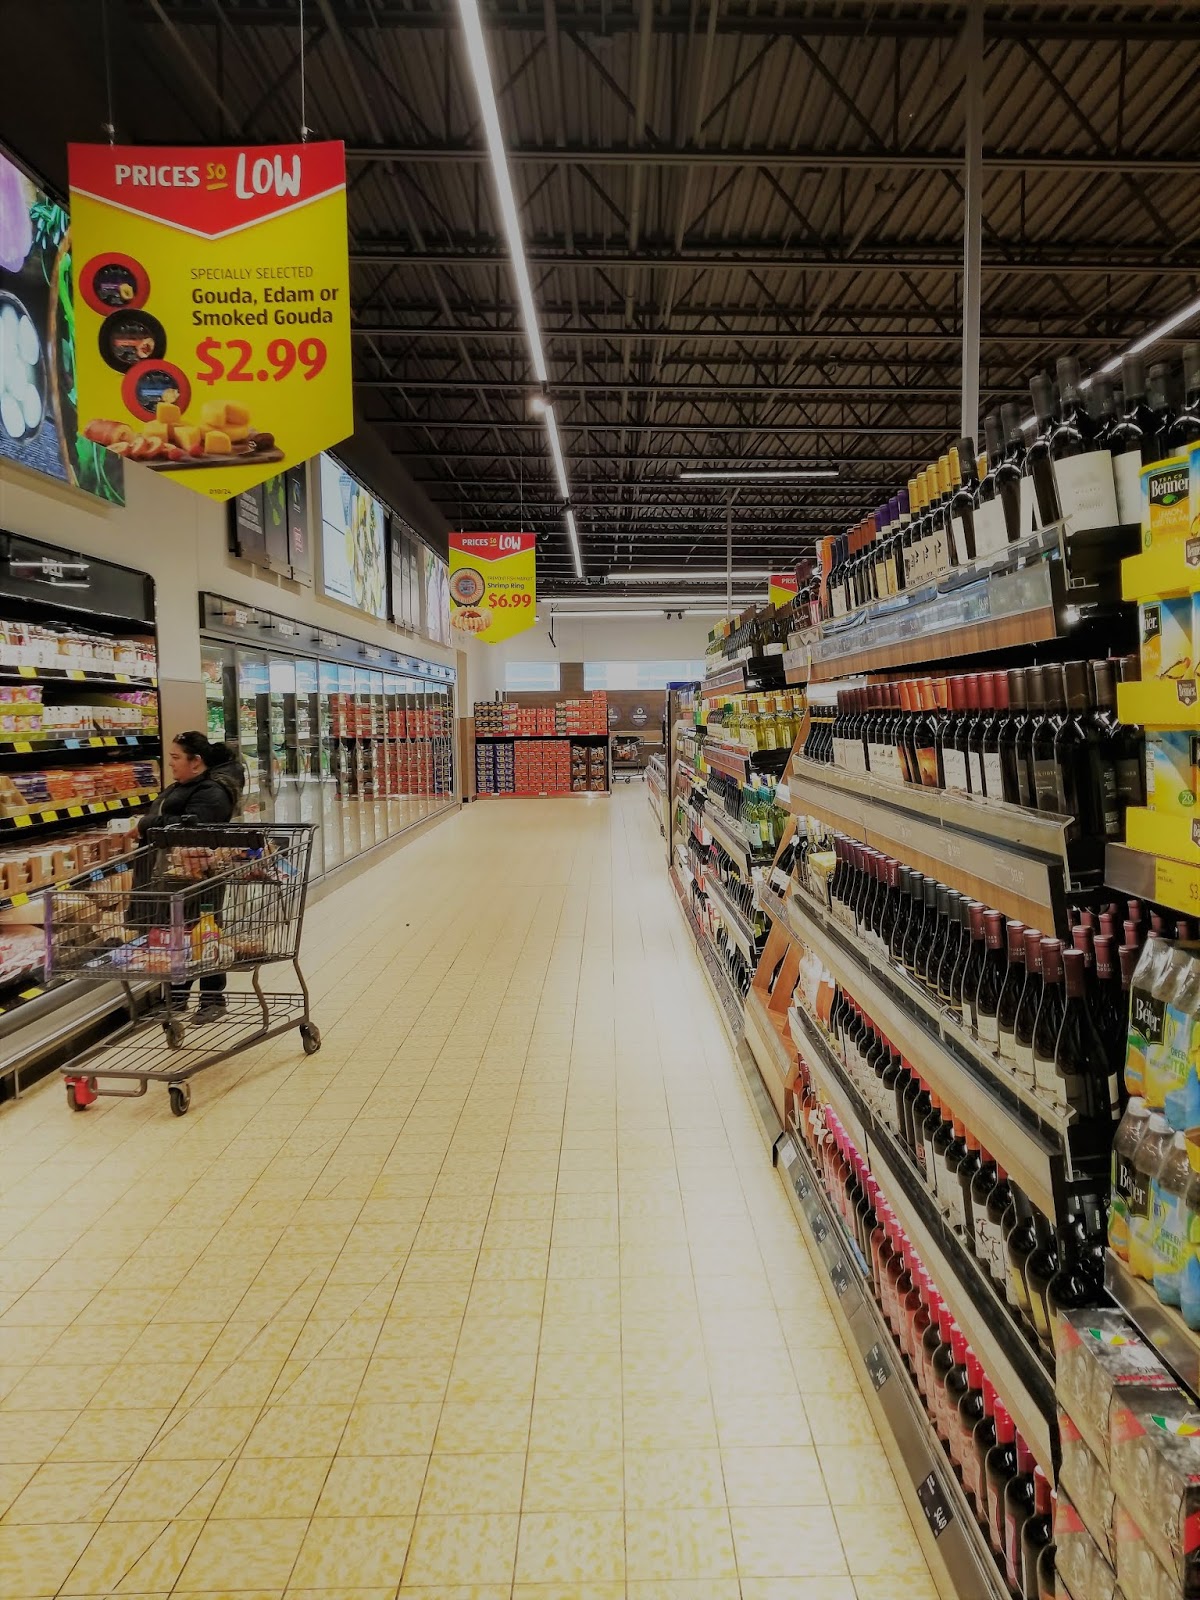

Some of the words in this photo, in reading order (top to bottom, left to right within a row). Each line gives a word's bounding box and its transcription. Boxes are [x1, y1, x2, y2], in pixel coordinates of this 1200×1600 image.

[115, 164, 200, 187] PRICES
[206, 163, 227, 180] SO
[236, 153, 301, 199] LOW
[190, 268, 250, 280] SPECIALLY
[256, 266, 313, 279] SELECTED
[192, 287, 257, 306] Gouda,
[264, 286, 314, 303] Edam
[320, 288, 339, 301] or
[192, 309, 268, 326] Smoked
[274, 307, 333, 325] Gouda
[196, 336, 327, 386] $2.99
[462, 538, 488, 546] PRICES
[499, 534, 521, 550] LOW
[511, 582, 524, 590] Ring
[488, 593, 532, 609] $6.99
